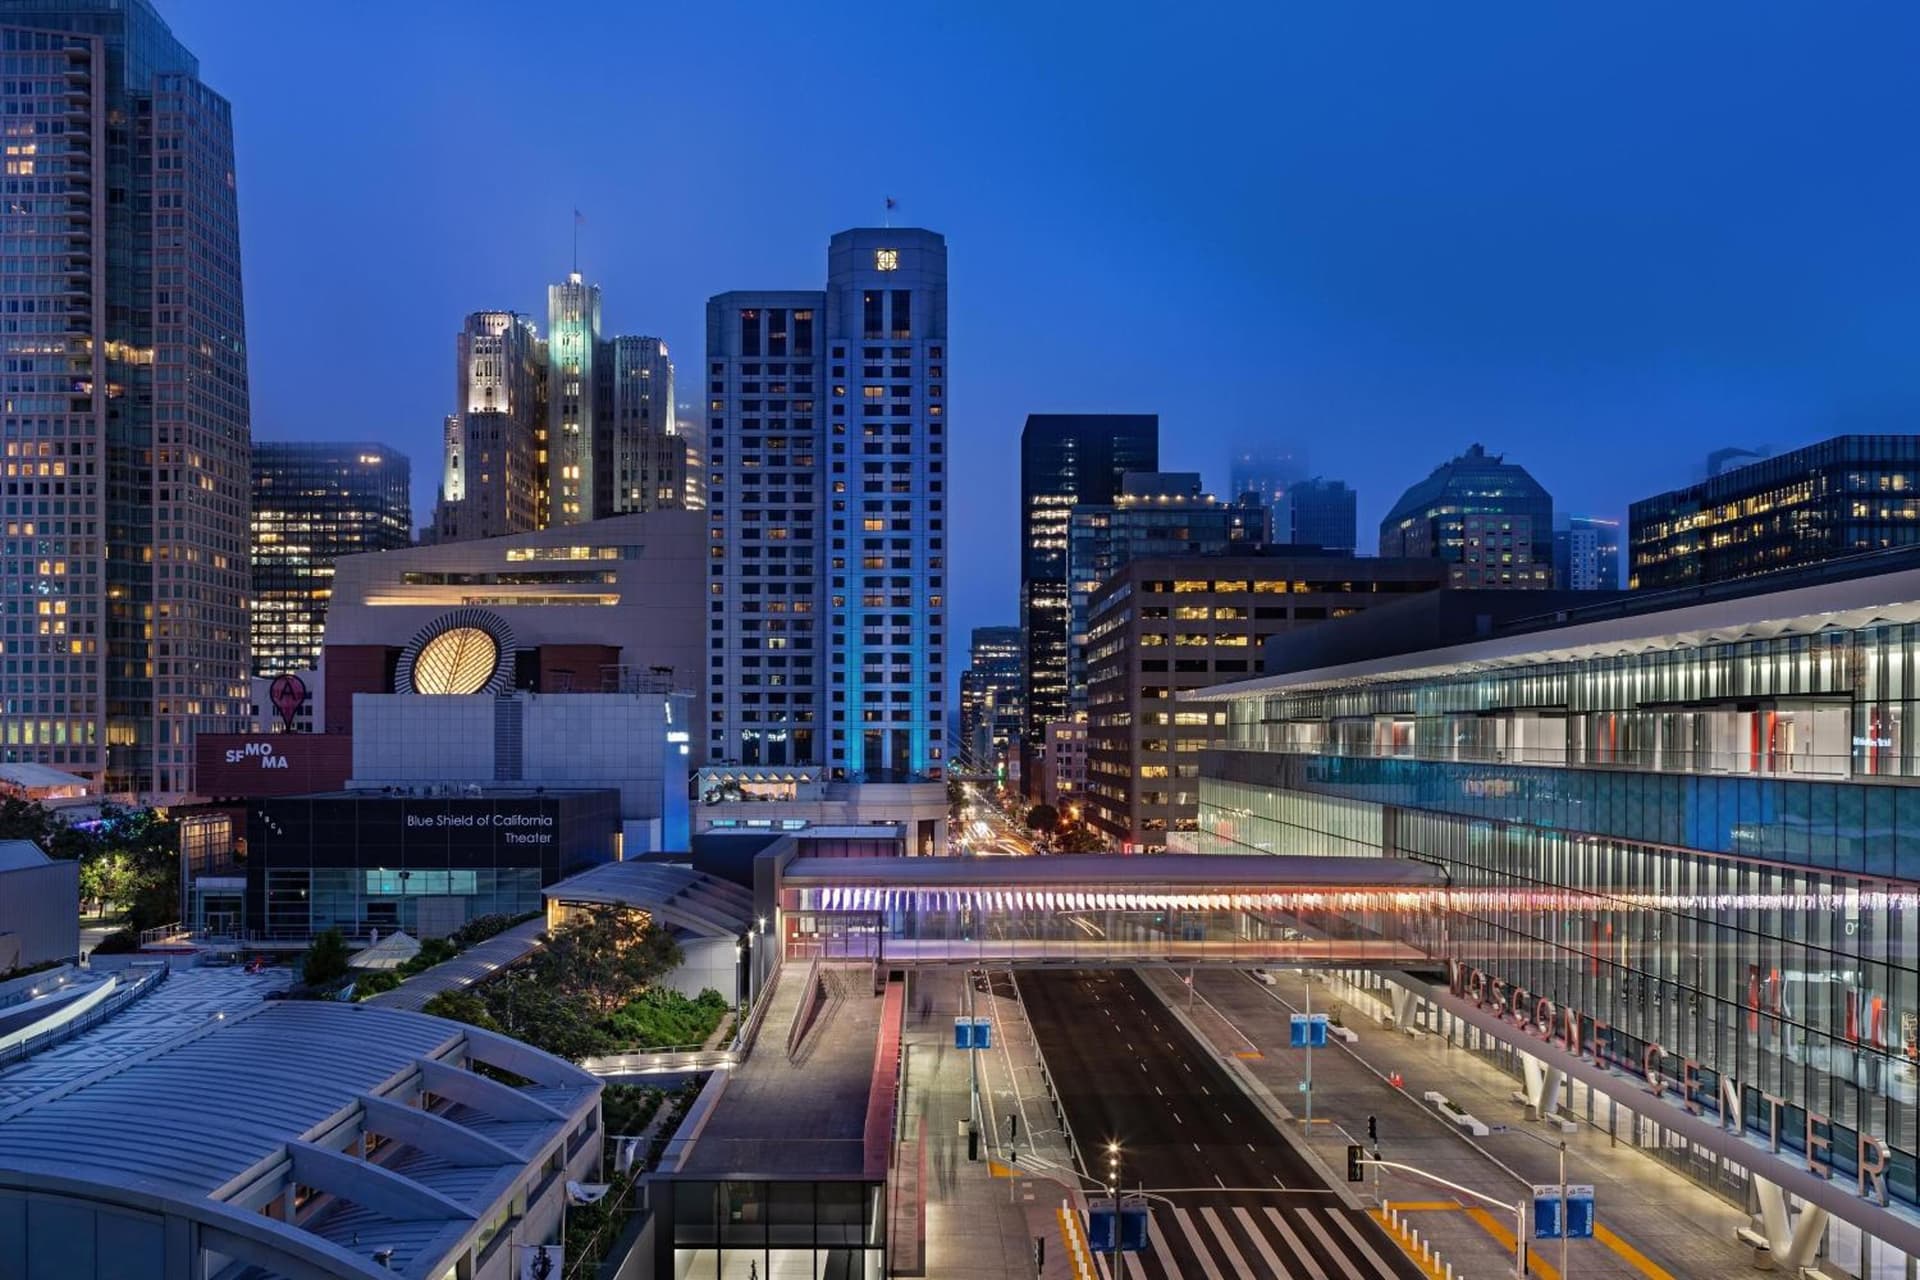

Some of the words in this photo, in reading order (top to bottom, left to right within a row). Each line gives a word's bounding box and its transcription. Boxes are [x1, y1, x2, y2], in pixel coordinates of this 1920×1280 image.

[407, 815, 433, 826] Blue
[436, 815, 473, 826] Shield
[477, 815, 490, 826] of
[493, 815, 553, 826] California
[505, 832, 552, 843] Theater
[1449, 958, 1610, 1070] MOSCONE
[1644, 1043, 1892, 1207] CENTER
